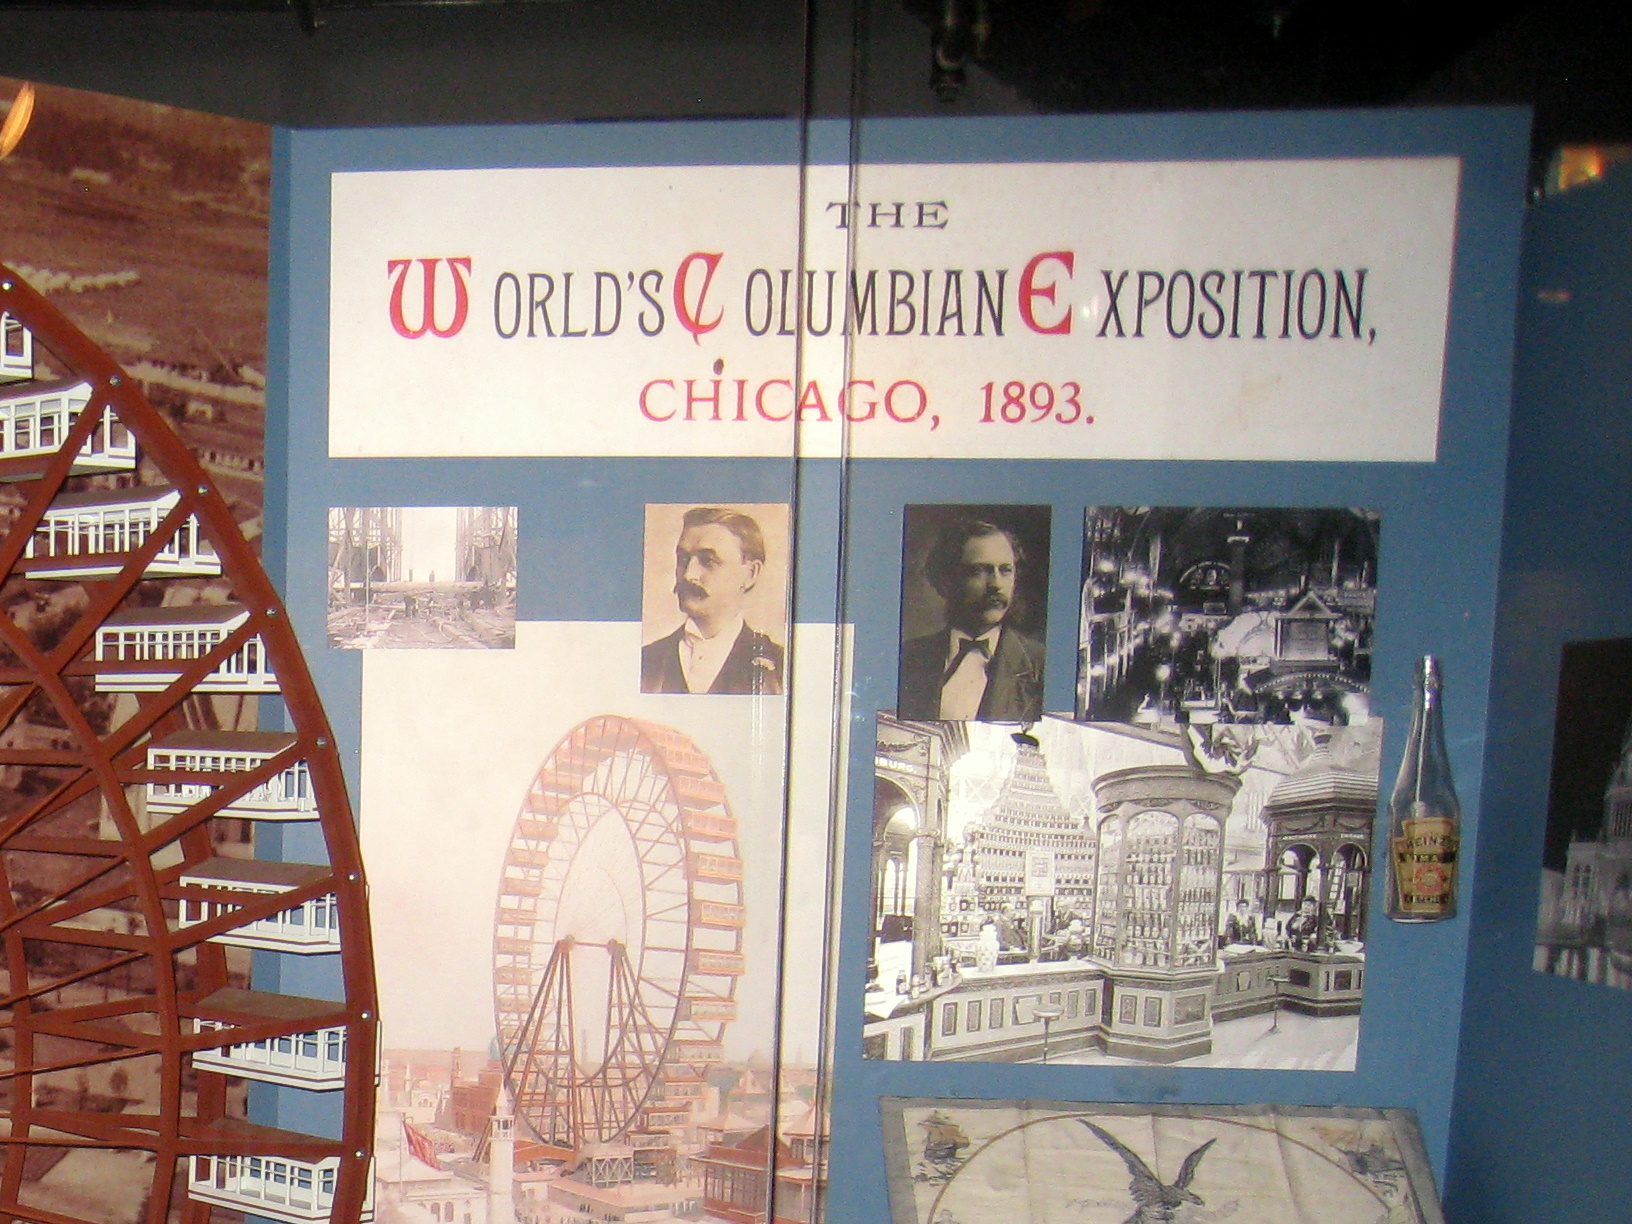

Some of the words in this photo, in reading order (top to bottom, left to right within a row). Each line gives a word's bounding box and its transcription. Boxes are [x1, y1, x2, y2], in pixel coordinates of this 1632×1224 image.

[826, 200, 949, 229] THE
[387, 255, 665, 340] WORLD'S
[672, 251, 1009, 346] COLUMBIAN
[1018, 250, 1376, 346] EXPOSITION,
[639, 378, 940, 431] CHICAGO,
[979, 379, 1094, 425] 1893.
